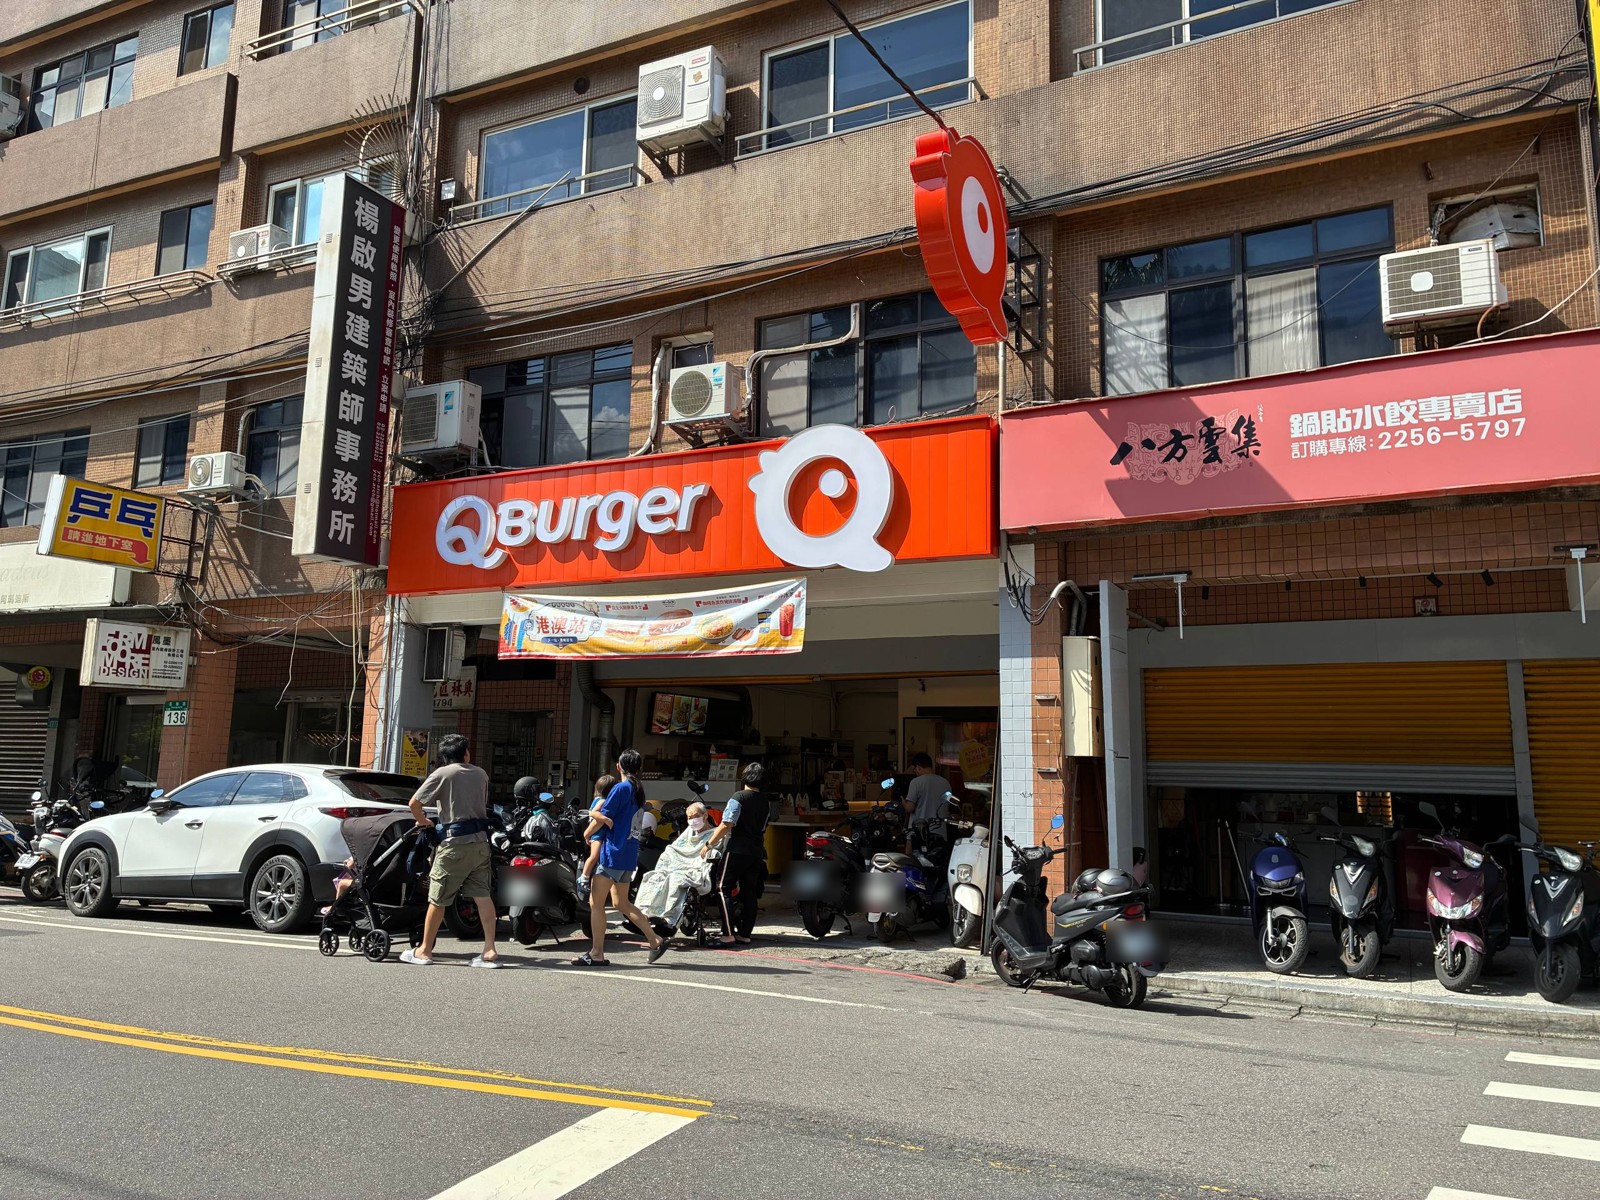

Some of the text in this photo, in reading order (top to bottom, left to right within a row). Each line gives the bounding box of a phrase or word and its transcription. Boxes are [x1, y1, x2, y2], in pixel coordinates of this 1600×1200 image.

[328, 196, 379, 545] 楊啟男建築師事務所
[1289, 388, 1522, 438] 鍋貼水餃專賣店
[1109, 414, 1261, 466] 八方雲集
[67, 487, 158, 538] 乒乓
[67, 529, 134, 551] 請進地下室
[536, 615, 586, 635] 港澳站
[99, 664, 150, 680] DESIGN
[167, 711, 186, 724] 136
